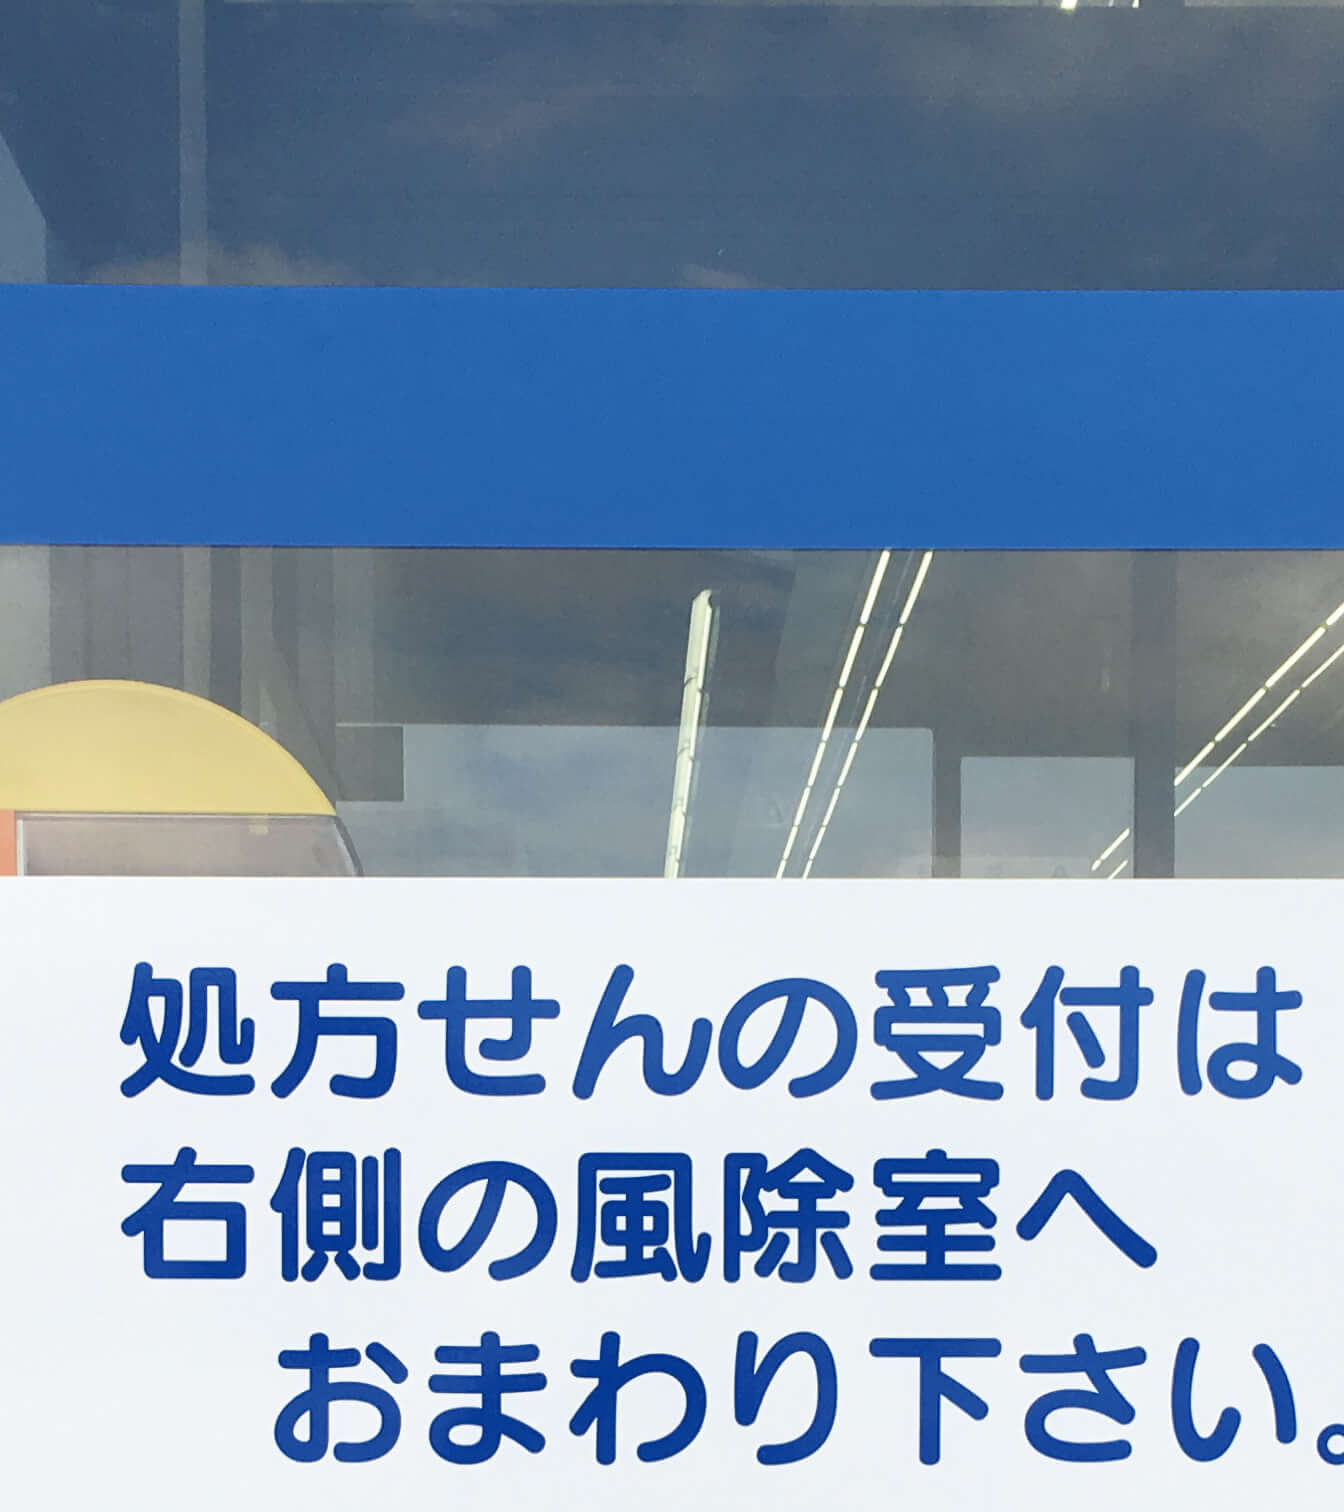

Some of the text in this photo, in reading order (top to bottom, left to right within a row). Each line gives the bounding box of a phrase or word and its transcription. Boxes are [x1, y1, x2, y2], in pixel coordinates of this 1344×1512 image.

[120, 962, 1304, 1101] 処方せんの受付は
[120, 1147, 1158, 1284] 右側の風除室へ
